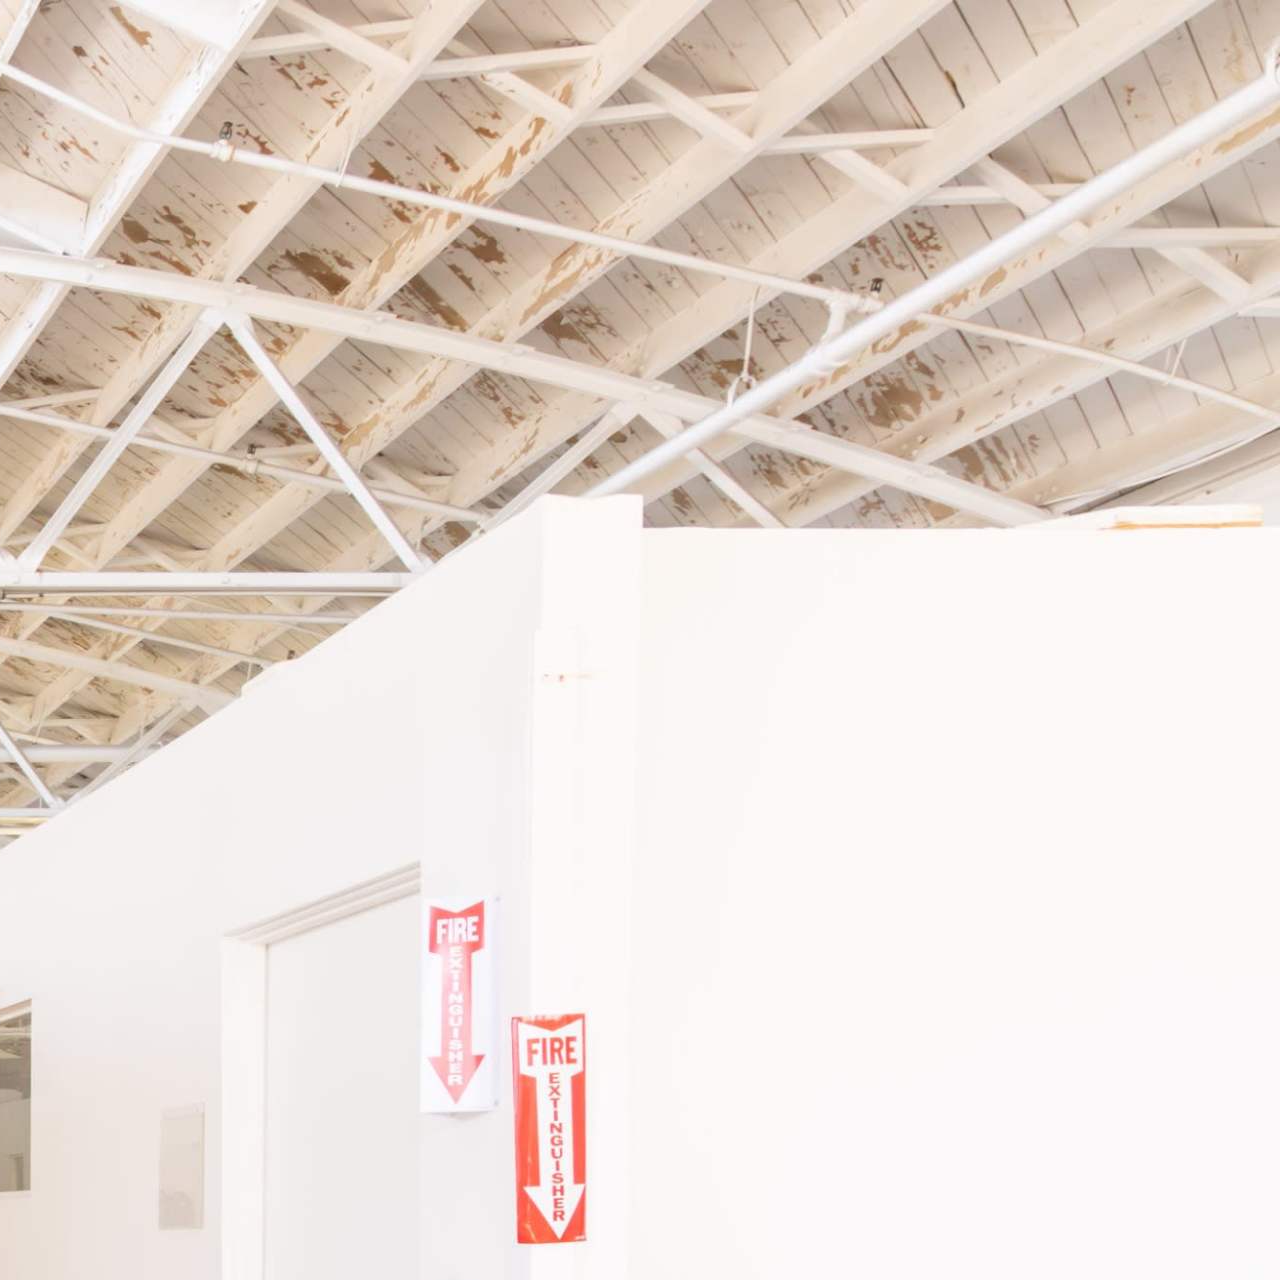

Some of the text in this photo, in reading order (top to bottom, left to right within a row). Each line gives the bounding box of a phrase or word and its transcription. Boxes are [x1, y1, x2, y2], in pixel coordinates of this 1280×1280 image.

[436, 915, 480, 944] FIRE
[447, 945, 465, 1086] EXTINGUISHER
[526, 1035, 577, 1066] FIRE
[548, 1072, 565, 1222] EXTINGUISHER
